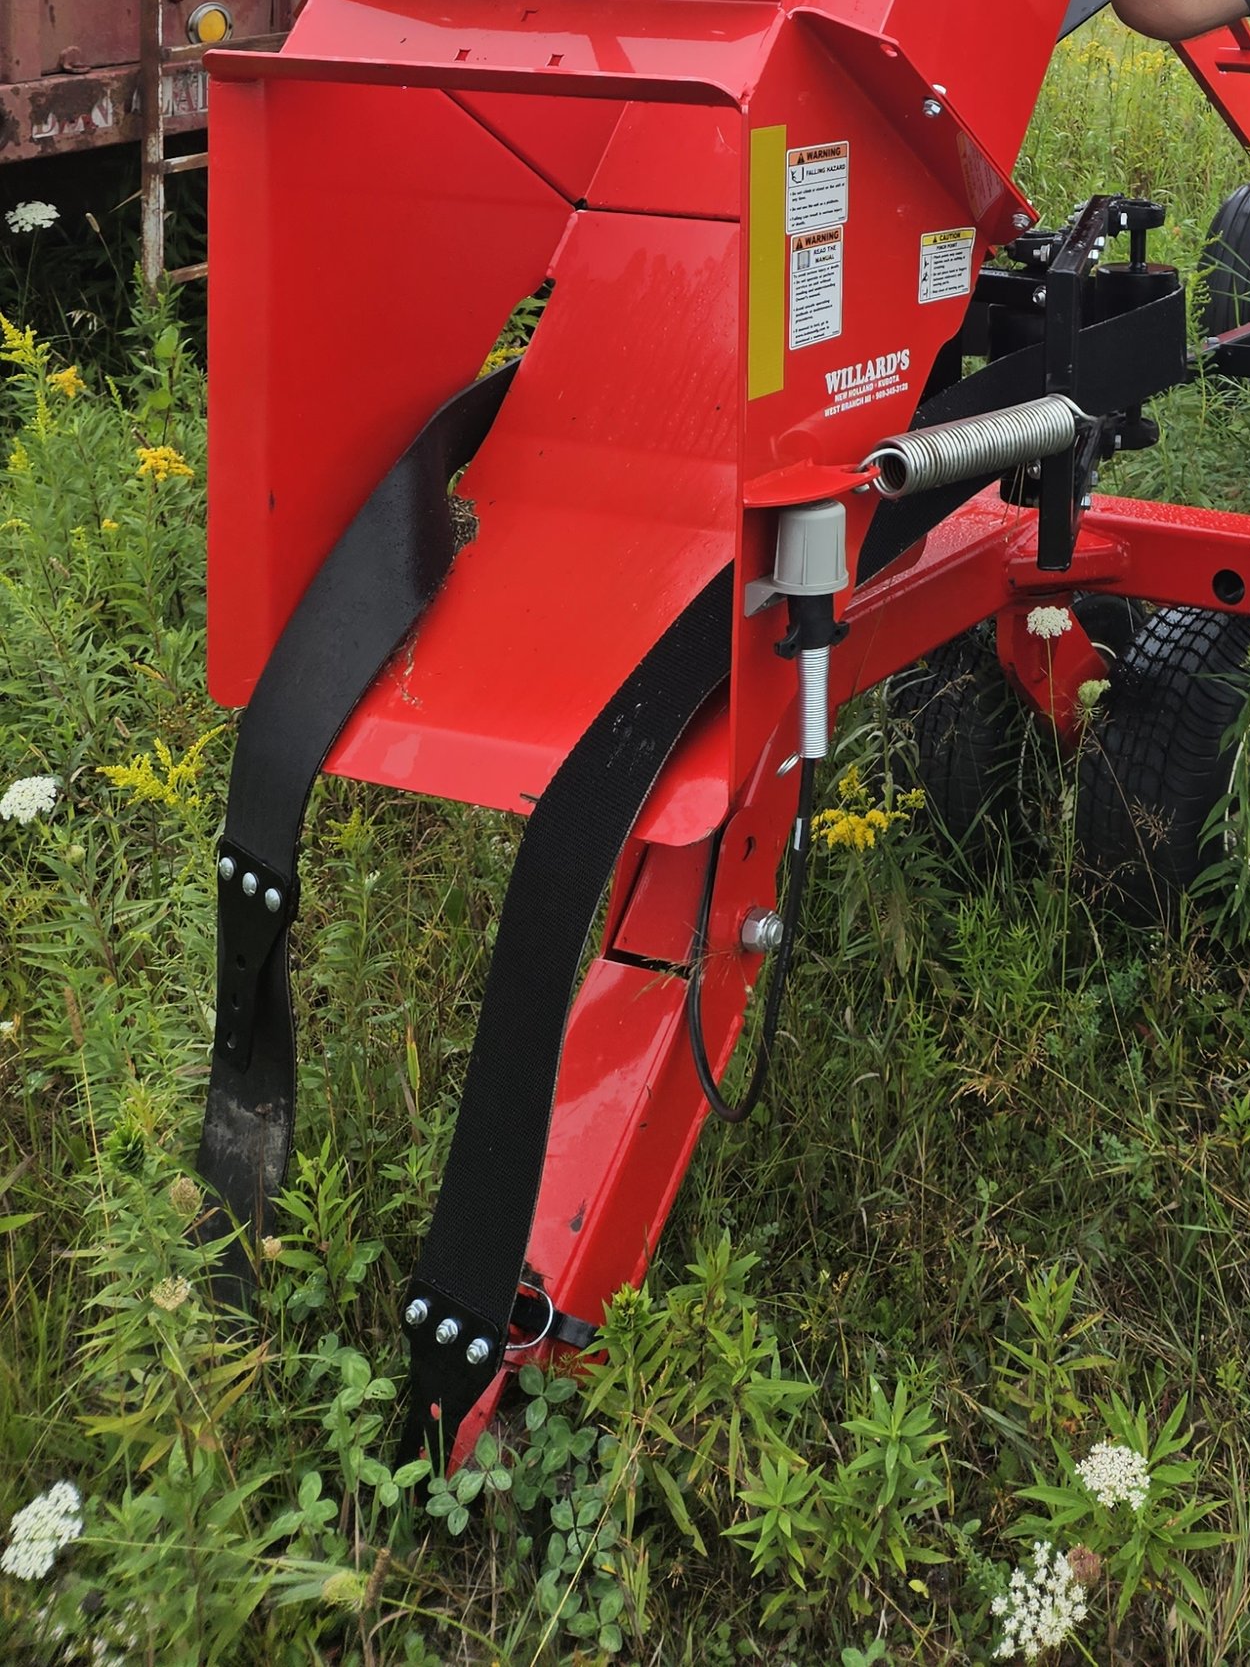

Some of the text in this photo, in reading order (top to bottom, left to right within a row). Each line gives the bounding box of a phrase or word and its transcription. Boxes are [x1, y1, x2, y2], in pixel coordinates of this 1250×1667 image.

[806, 147, 841, 161] WARNING
[806, 163, 846, 176] FALLING HAZARD
[804, 230, 839, 246] WARNING
[939, 233, 961, 241] CAUTION
[815, 254, 834, 263] MANUAL
[825, 349, 909, 394] WILLARD'S
[835, 375, 899, 402] NEW HOLLAND KUBOTA
[825, 405, 840, 417] WEST
[841, 397, 863, 411] BRANCH
